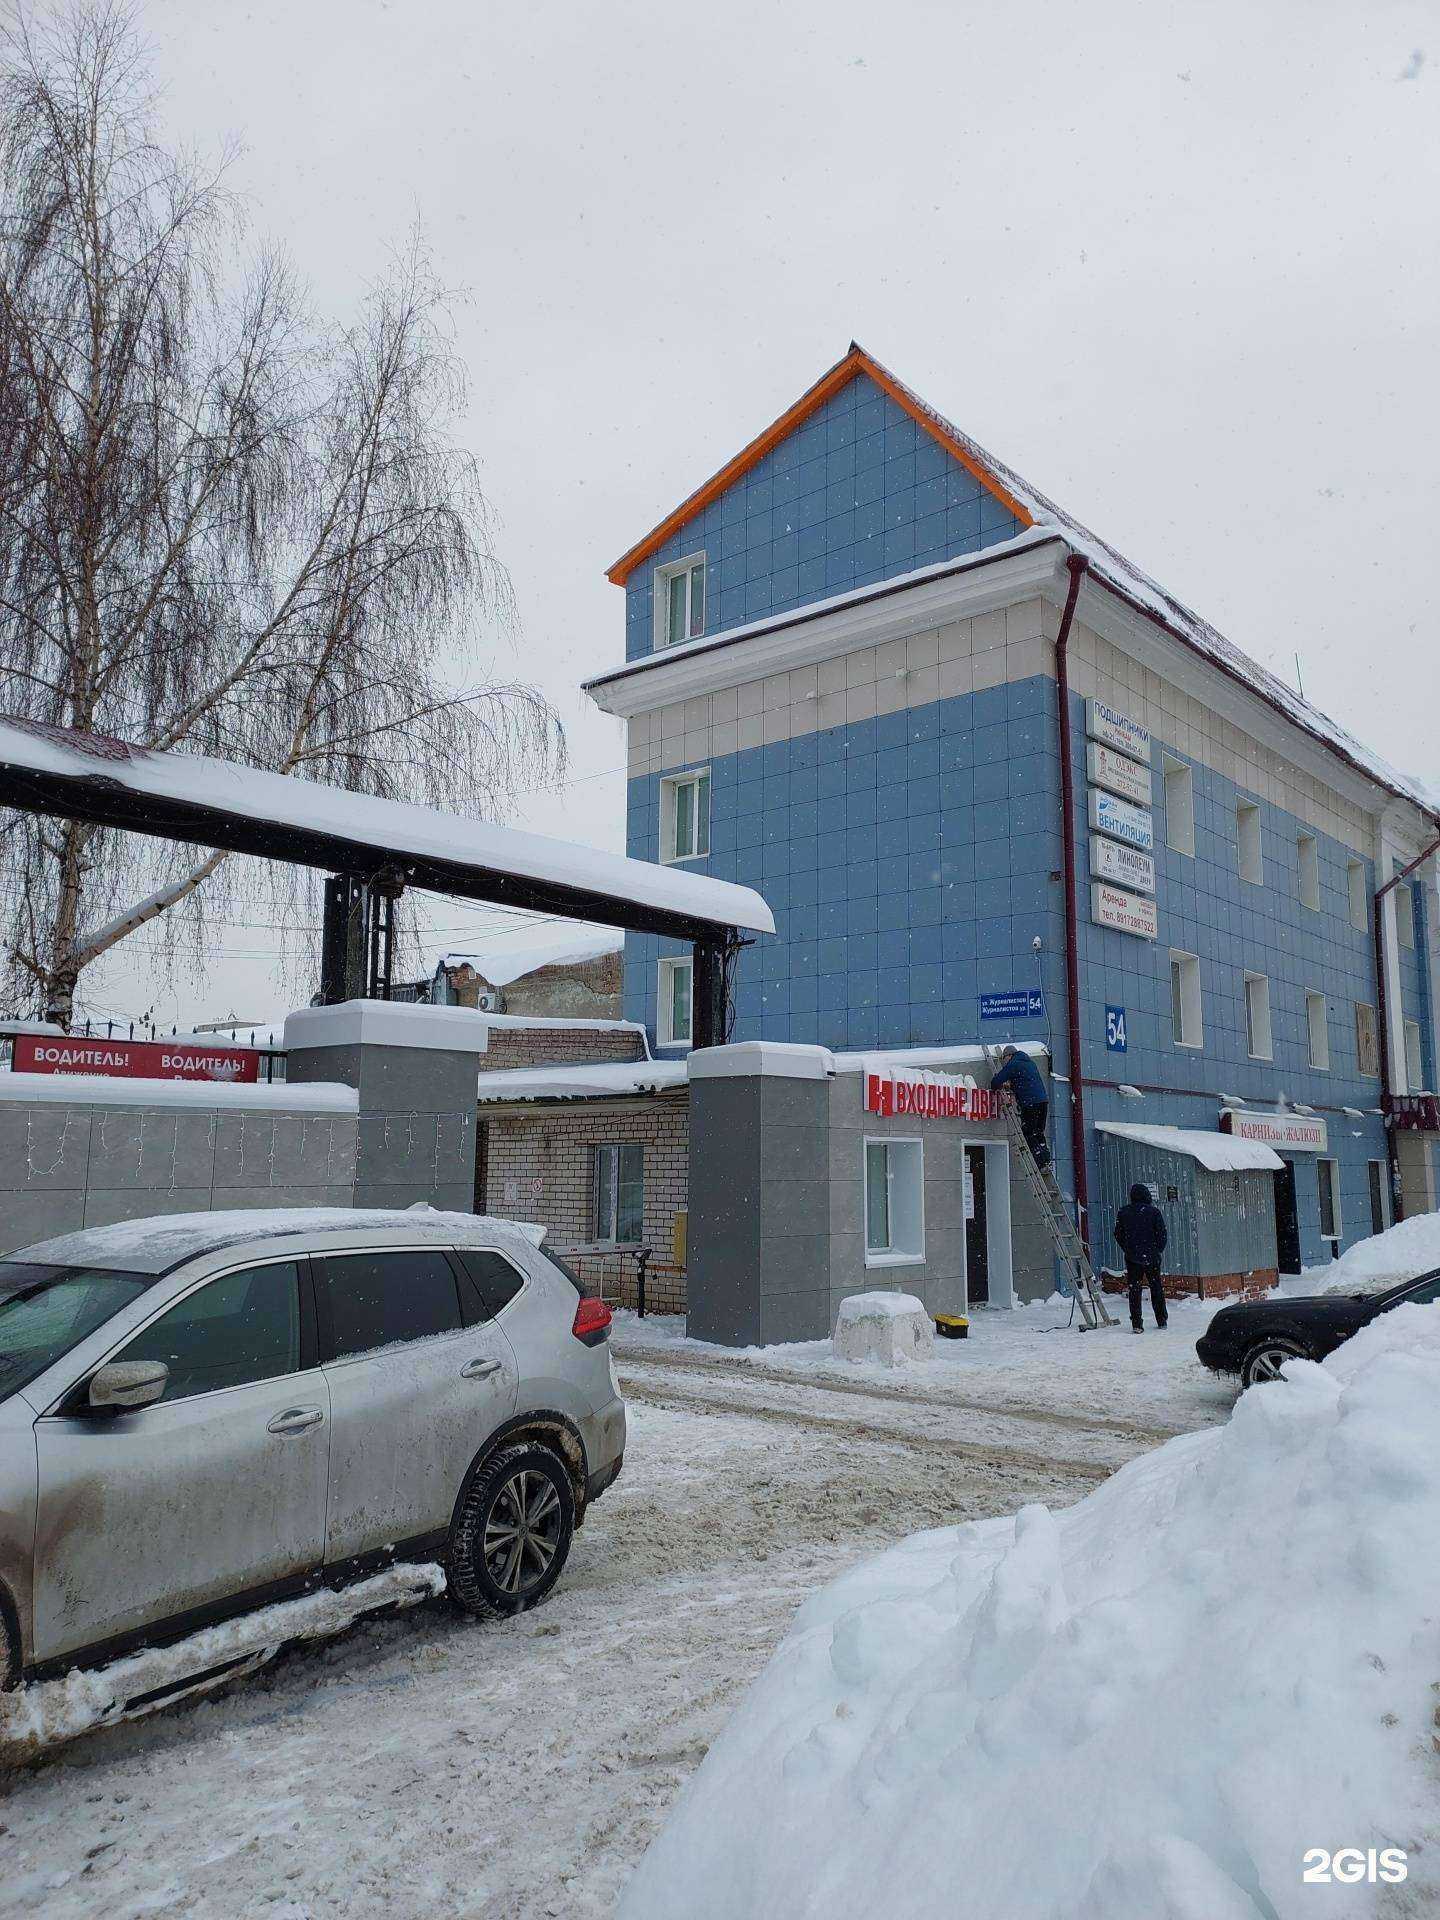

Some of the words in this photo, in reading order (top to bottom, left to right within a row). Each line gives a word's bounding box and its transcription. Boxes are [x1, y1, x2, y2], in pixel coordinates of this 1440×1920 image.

[1098, 812, 1151, 846] ВЕНТИЛЯЦИЯ
[1118, 847, 1151, 874] ЛИНОЛЕУМ
[1101, 889, 1128, 909] Аренда
[1029, 997, 1041, 1010] 54
[1108, 1012, 1126, 1047] 54
[34, 1047, 129, 1067] ВОДИТЕЛЬ!
[161, 1055, 246, 1072] ВОДИТЕЛЬ!
[897, 1081, 968, 1119] ВХОДНЫЕ
[1286, 1126, 1322, 1143] ЖАЛЮЗИ
